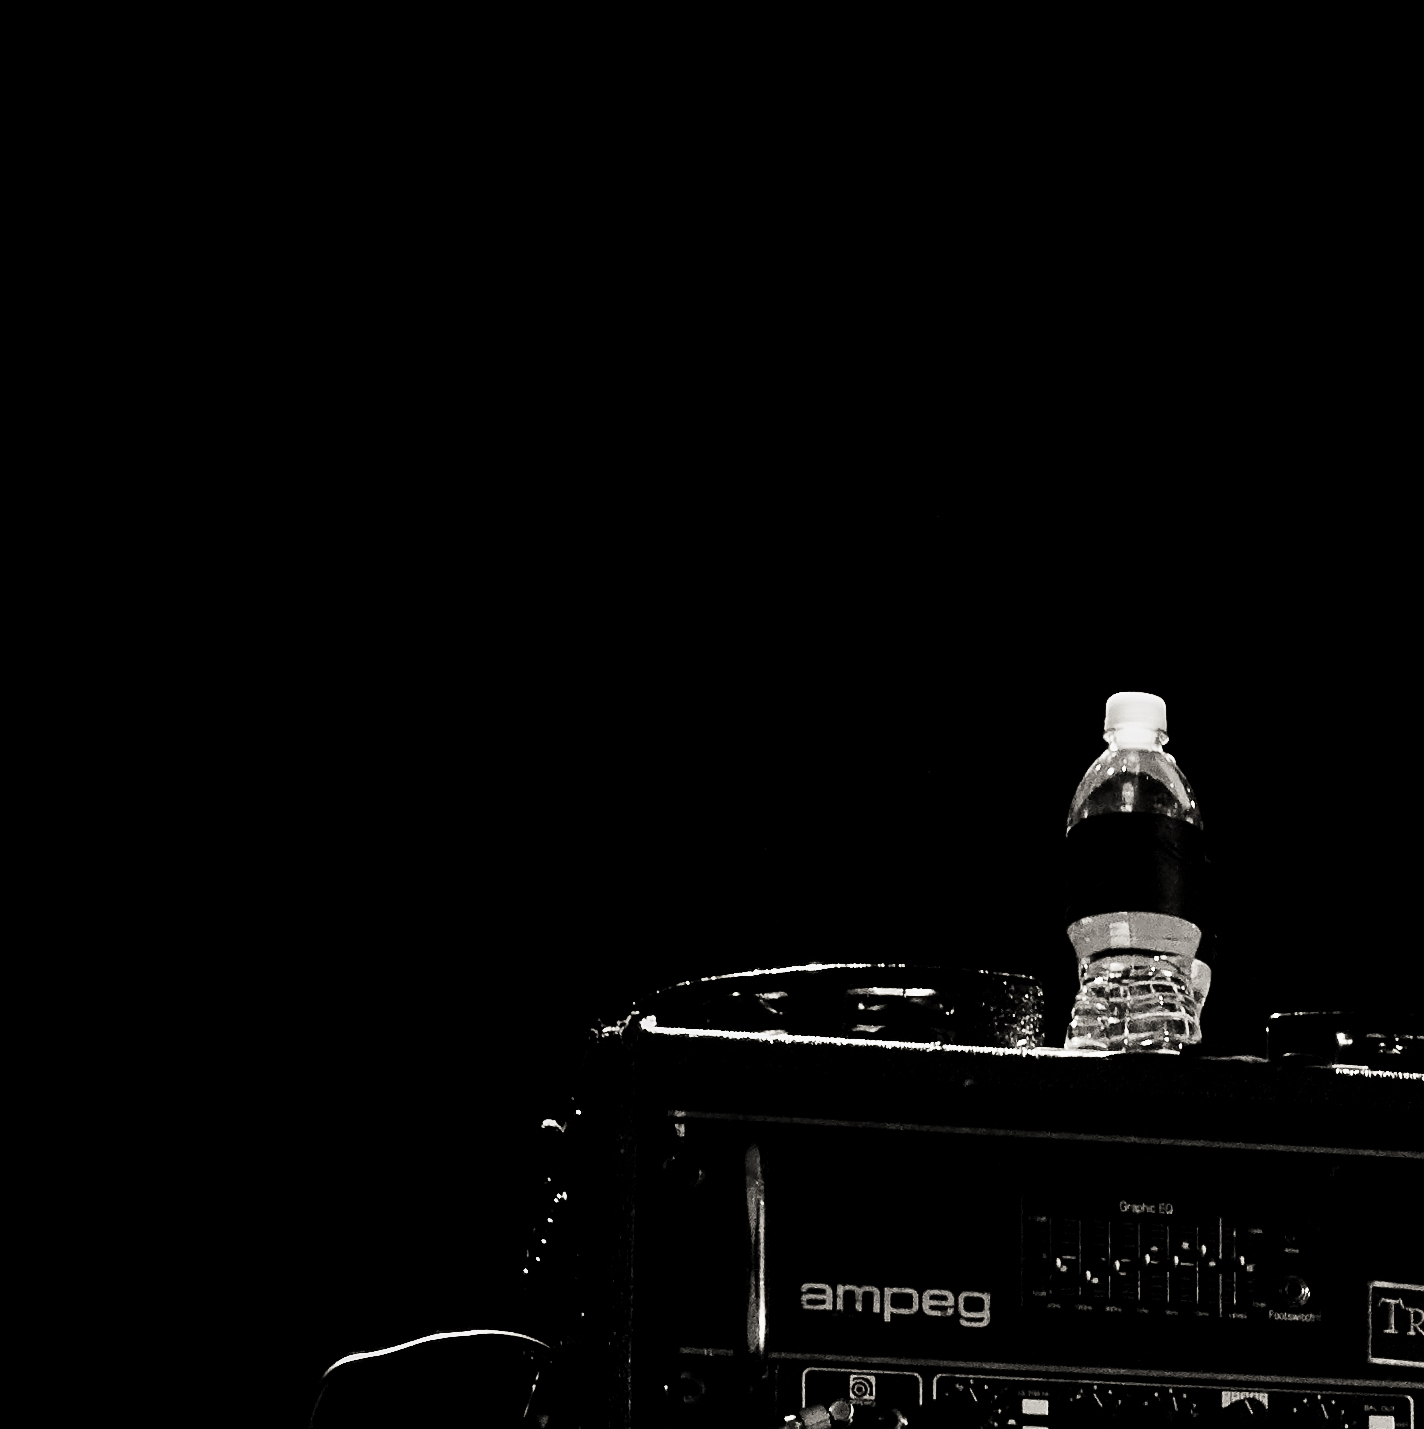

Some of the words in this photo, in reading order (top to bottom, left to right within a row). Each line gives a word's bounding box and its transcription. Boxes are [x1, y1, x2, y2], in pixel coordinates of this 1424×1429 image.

[1119, 1200, 1156, 1216] Graphic
[1158, 1202, 1174, 1215] EQ
[800, 1281, 991, 1328] ampeg
